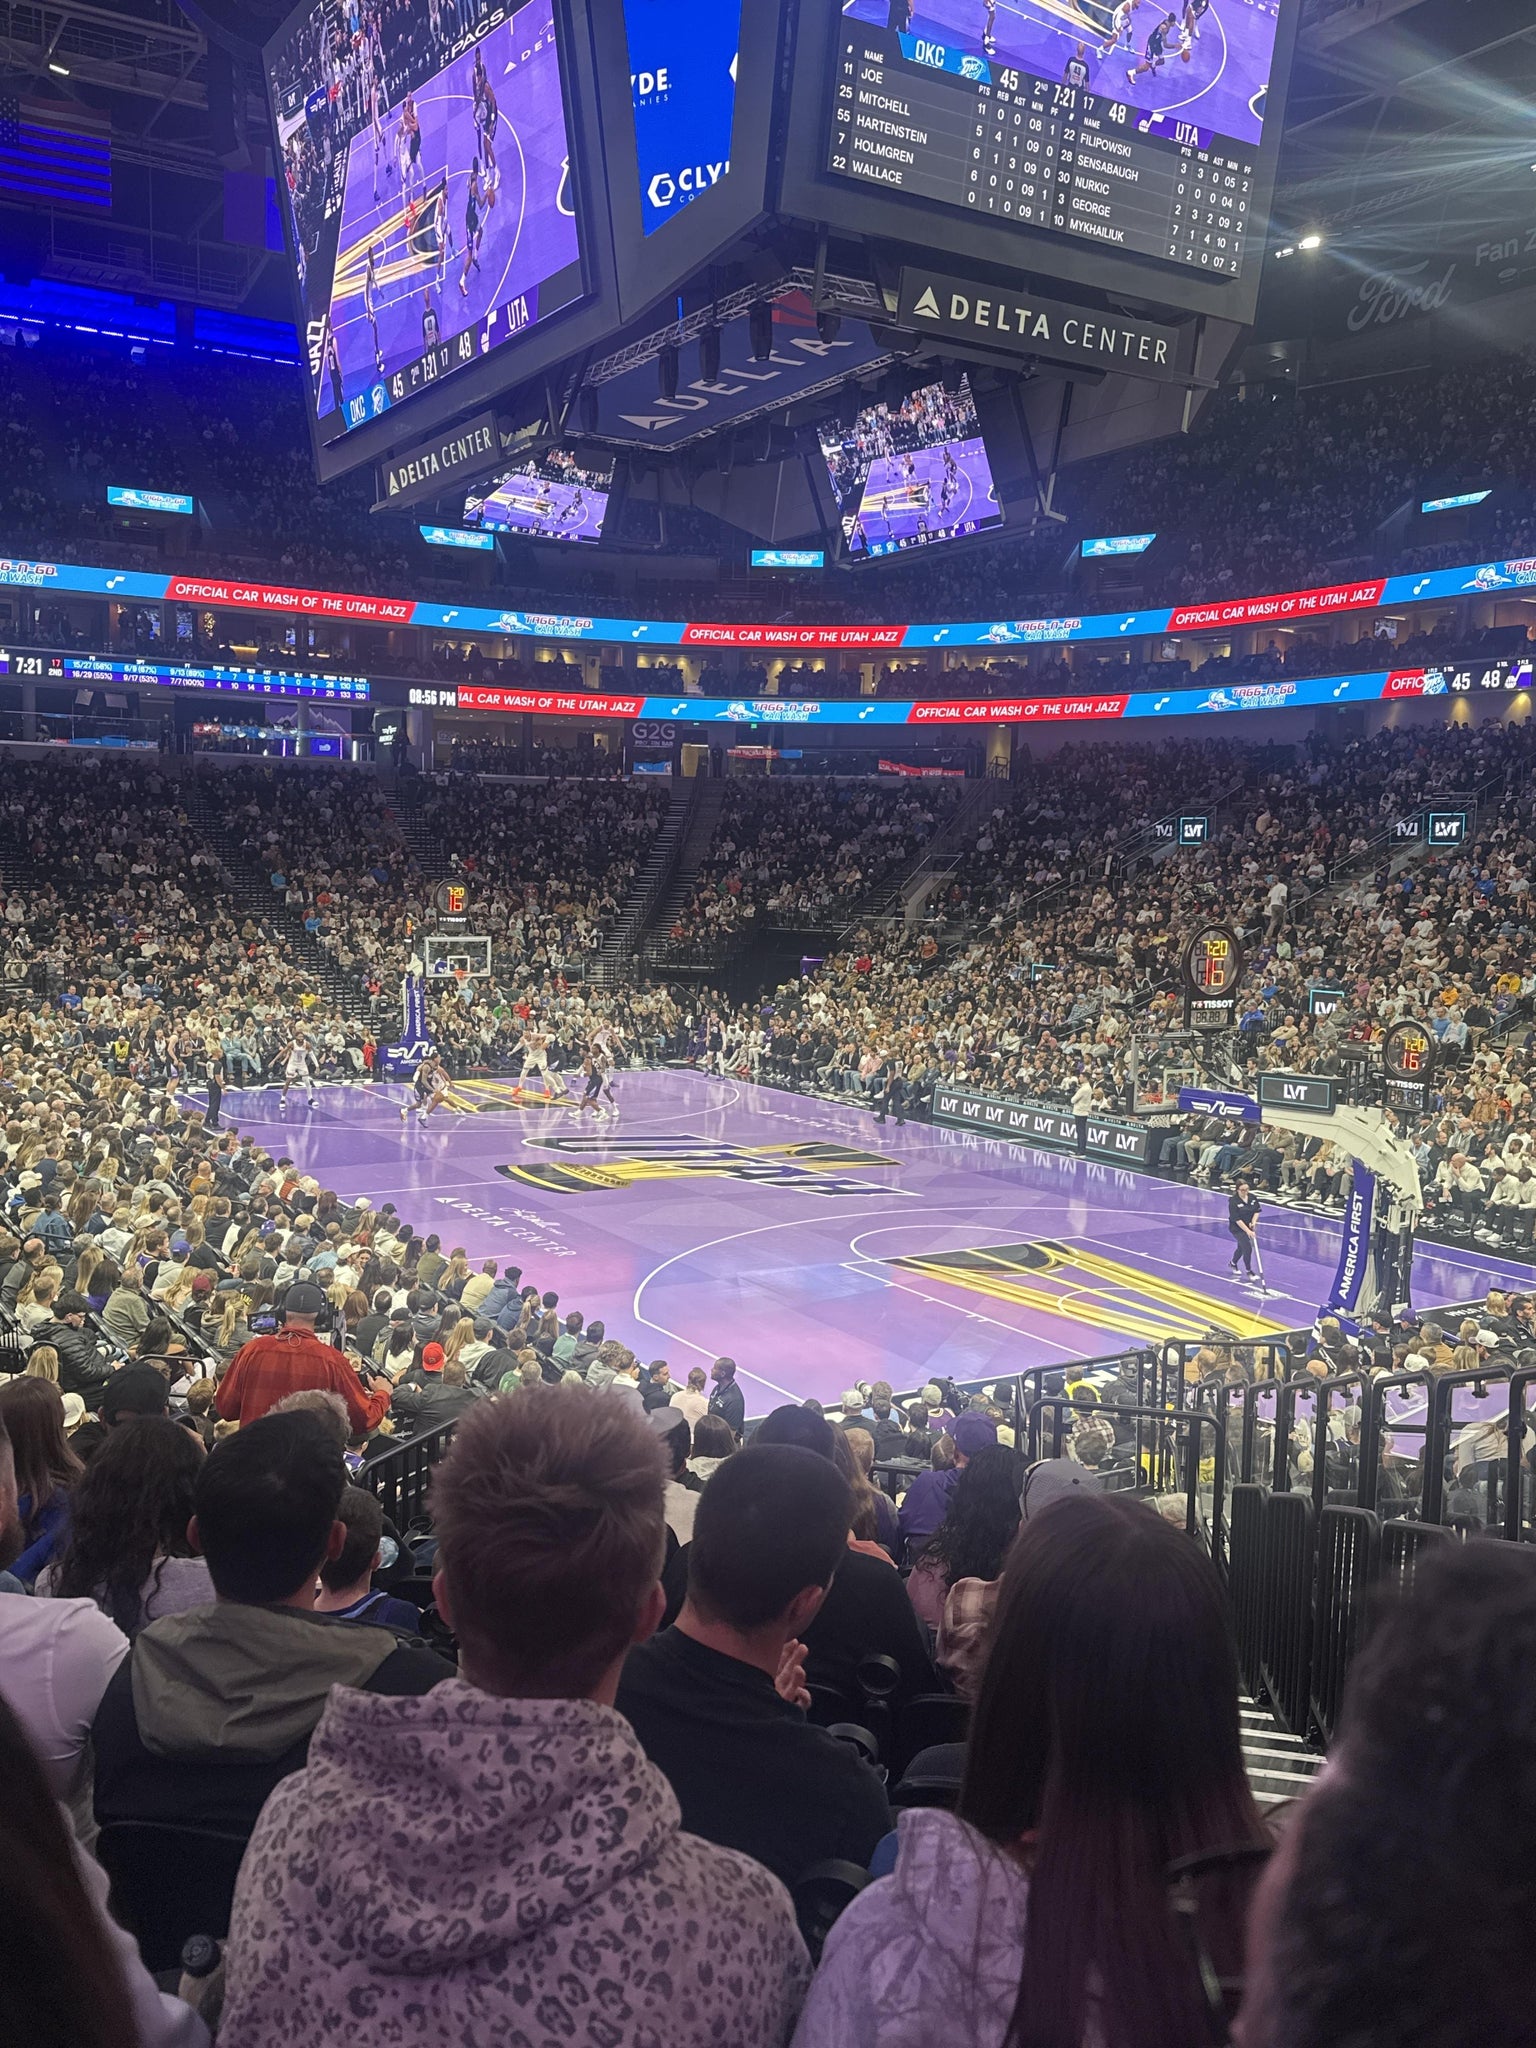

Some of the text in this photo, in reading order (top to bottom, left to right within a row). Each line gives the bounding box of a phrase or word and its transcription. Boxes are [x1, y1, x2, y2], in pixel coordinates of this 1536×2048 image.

[864, 49, 883, 64] NAME
[915, 39, 945, 67] OKC
[844, 62, 1055, 136] 11 JOE 11 0 0 08 1
[1000, 68, 1019, 91] 45
[1053, 84, 1075, 109] 7:21
[1083, 96, 1094, 110] 17
[1108, 102, 1126, 124] 48
[840, 85, 1053, 157] 25 MITCHELL 5 4 1 09 0
[1083, 117, 1101, 129] NAME
[1175, 121, 1199, 146] UTA
[837, 108, 1037, 175] 55 HARTENSTEIN 09
[838, 132, 1034, 197] 7 HOLMGREN 09
[1063, 128, 1236, 188] 22 FILIPOWSKI 05
[832, 155, 1032, 218] 22 WALLACE 09
[1060, 149, 1233, 209] 28 SENSABAUGH 04
[1058, 171, 1230, 229] 30 NURKIC 09
[1058, 193, 1226, 249] 3 GEORGE 10
[1054, 214, 1225, 268] 10 MYKHAILIUK 07
[1475, 238, 1519, 266] Fan
[1347, 260, 1456, 331] Ford
[507, 295, 529, 331] UTA
[949, 293, 1168, 364] DELTA CENTER
[349, 395, 366, 422] OKC
[393, 372, 404, 399] 45
[440, 347, 449, 367] 17
[459, 331, 472, 360] 48
[398, 426, 493, 489] DELTA CENTER
[175, 582, 407, 618] OFFICIAL CAR WASH OF THE UTAH JAZZ
[1175, 587, 1377, 625] OFFICIAL CAR WASH OF THE UTAH JAZZ
[534, 625, 582, 637] CAR WASH
[689, 628, 899, 642] OFFICIAL CAR WASH OF THE UTAH JAZZ
[1023, 628, 1070, 641] CAR WASH
[15, 656, 42, 675] 7:21
[51, 658, 61, 667] 17
[1452, 670, 1500, 690] 45 48
[409, 688, 456, 706] 08:56 PM
[458, 692, 636, 713] IAL CAR WASH OF THE UTAH JAZZ
[915, 700, 1120, 718] OFFICIAL CAR WASH OF THE UTAH JAZZ
[1241, 694, 1286, 708] CAR WASH
[762, 711, 809, 721] CAR WASH
[632, 722, 676, 740] G2G
[1184, 824, 1203, 837] LVT
[1435, 822, 1460, 836] LVT
[449, 896, 463, 912] 16
[1203, 940, 1229, 956] 7:20
[1205, 958, 1225, 986] 16
[1203, 1000, 1234, 1009] TISSOT
[1401, 1036, 1426, 1053] 7:20
[1403, 1052, 1419, 1071] 16
[1283, 1083, 1308, 1101] LVT
[1396, 1081, 1425, 1091] TISSOT
[941, 1096, 958, 1112] LVT
[962, 1101, 981, 1117] LVT
[985, 1106, 1004, 1123] LVT
[1009, 1110, 1029, 1128] LVT
[1034, 1116, 1055, 1133] LVT
[1087, 1127, 1110, 1145] LVT
[1115, 1133, 1139, 1151] LVT
[451, 1202, 510, 1226] DELTA
[504, 1227, 577, 1256] CENTER
[1338, 1191, 1364, 1300] AMERICA FIRST
